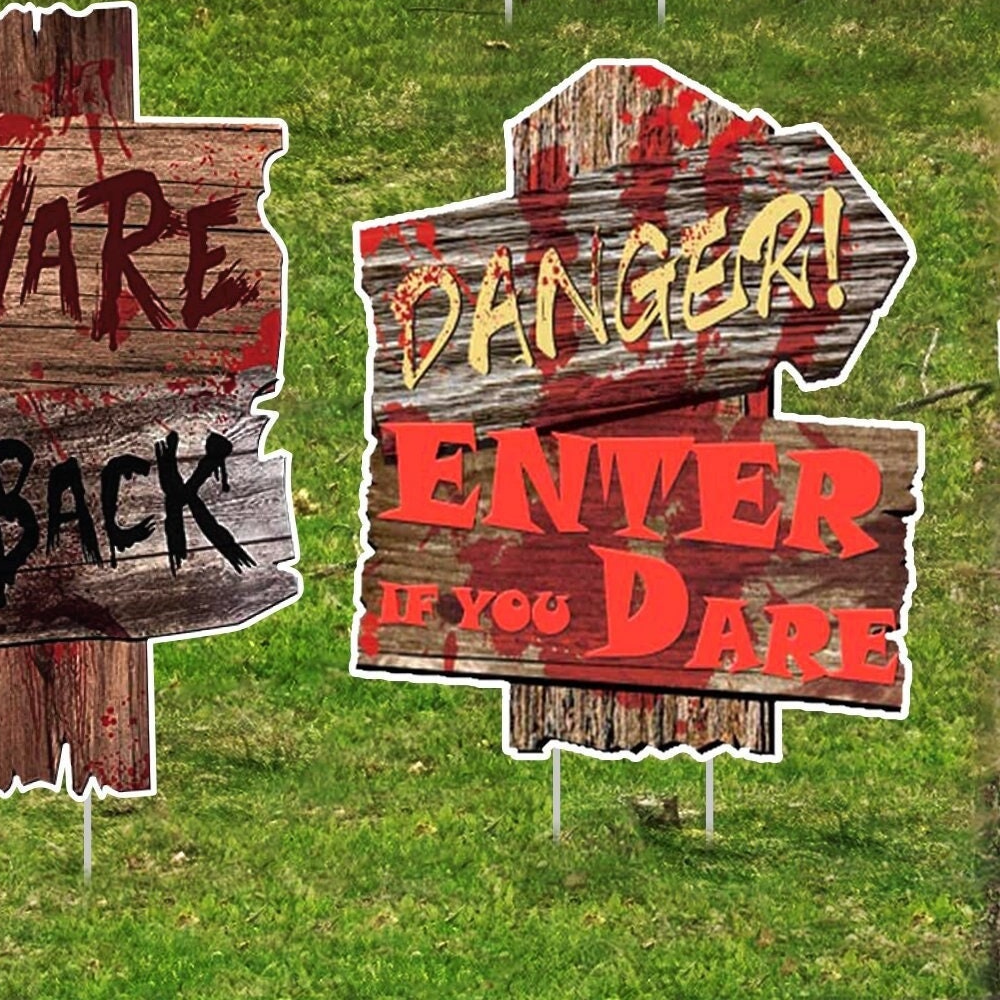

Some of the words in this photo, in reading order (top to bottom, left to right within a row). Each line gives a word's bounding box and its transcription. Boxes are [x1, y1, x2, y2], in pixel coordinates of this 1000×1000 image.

[389, 186, 847, 390] DANGER!
[378, 421, 884, 560] ENTER
[377, 580, 440, 628] IF
[453, 586, 571, 636] YOU
[584, 543, 900, 686] DARE
